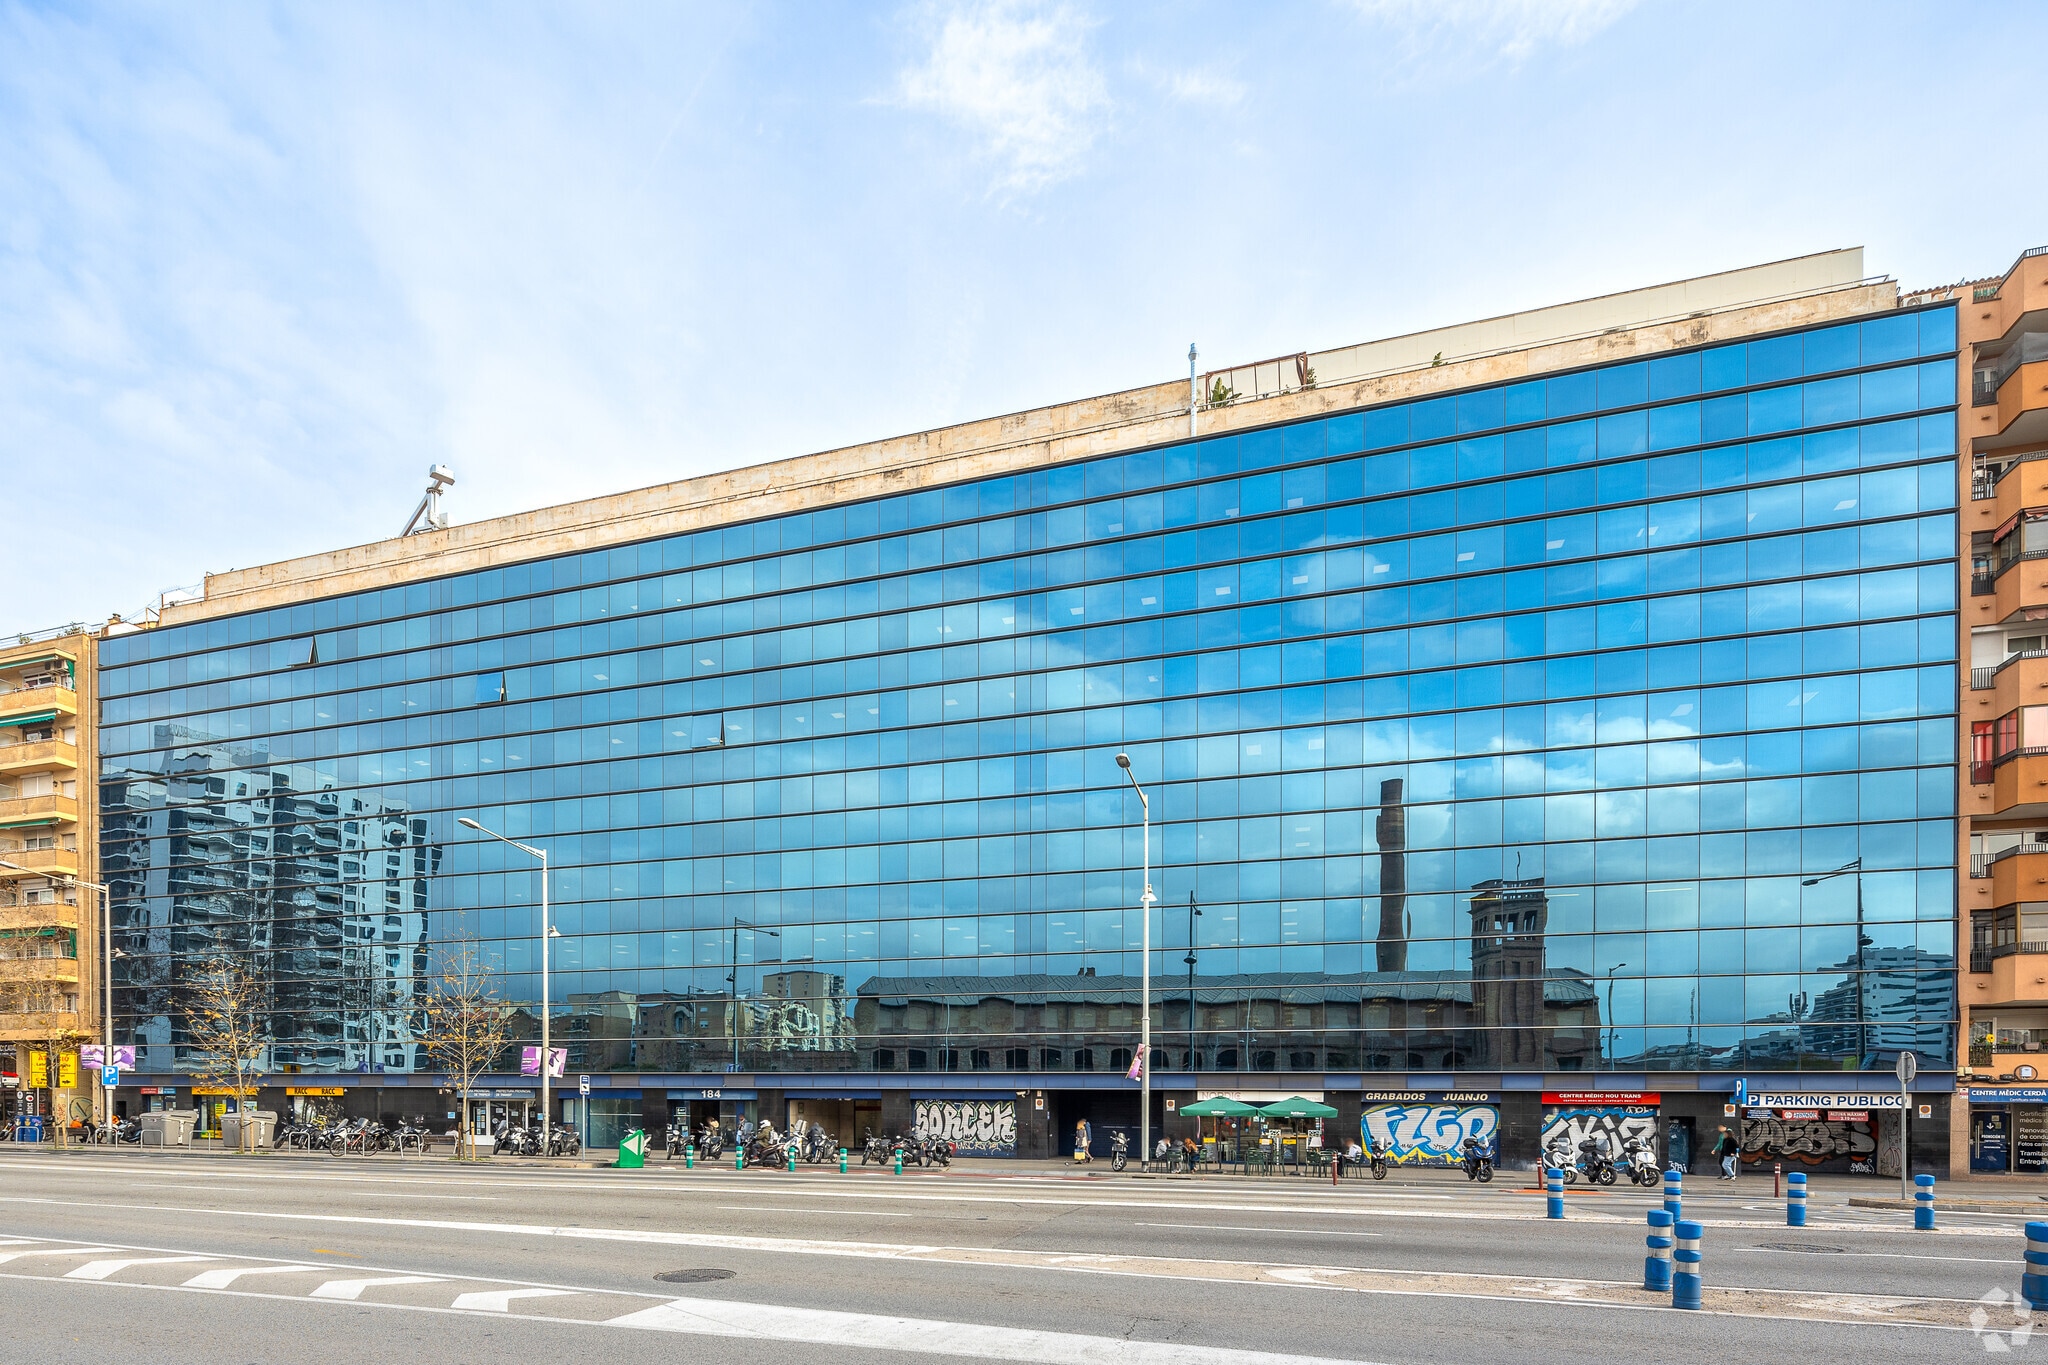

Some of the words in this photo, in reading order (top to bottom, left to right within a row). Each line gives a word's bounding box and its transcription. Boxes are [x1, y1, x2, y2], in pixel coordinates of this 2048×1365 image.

[105, 1067, 116, 1078] P
[1736, 1080, 1742, 1096] P
[701, 1090, 721, 1099] 184
[1365, 1092, 1426, 1101] GRABADOS
[1442, 1093, 1489, 1101] JUANJO
[1765, 1095, 1831, 1106] PARKING
